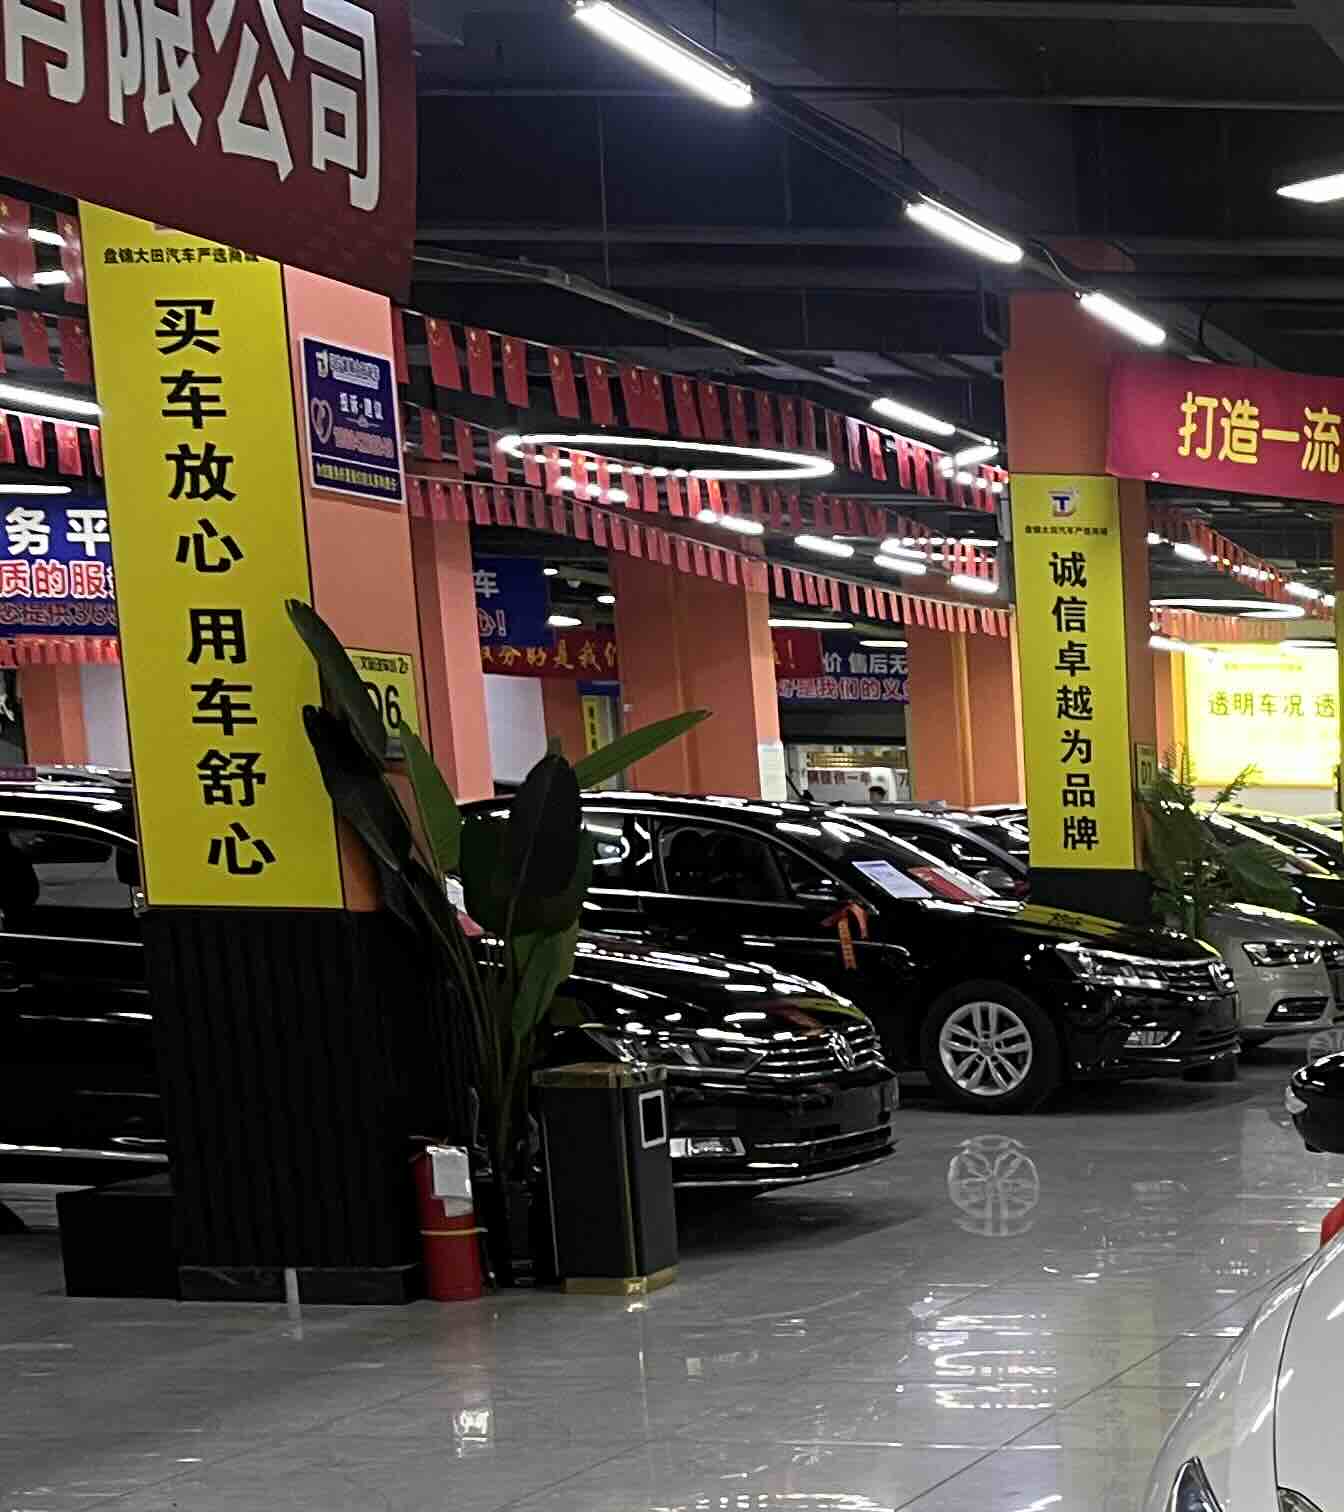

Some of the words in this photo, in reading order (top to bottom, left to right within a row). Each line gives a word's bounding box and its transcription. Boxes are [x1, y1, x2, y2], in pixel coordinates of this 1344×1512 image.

[154, 297, 243, 575] 买车放心
[0, 559, 116, 599] 质的服
[1049, 551, 1100, 851] 诚信卓越为品牌
[1209, 691, 1305, 718] 透明车况
[186, 606, 276, 876] 用车舒心
